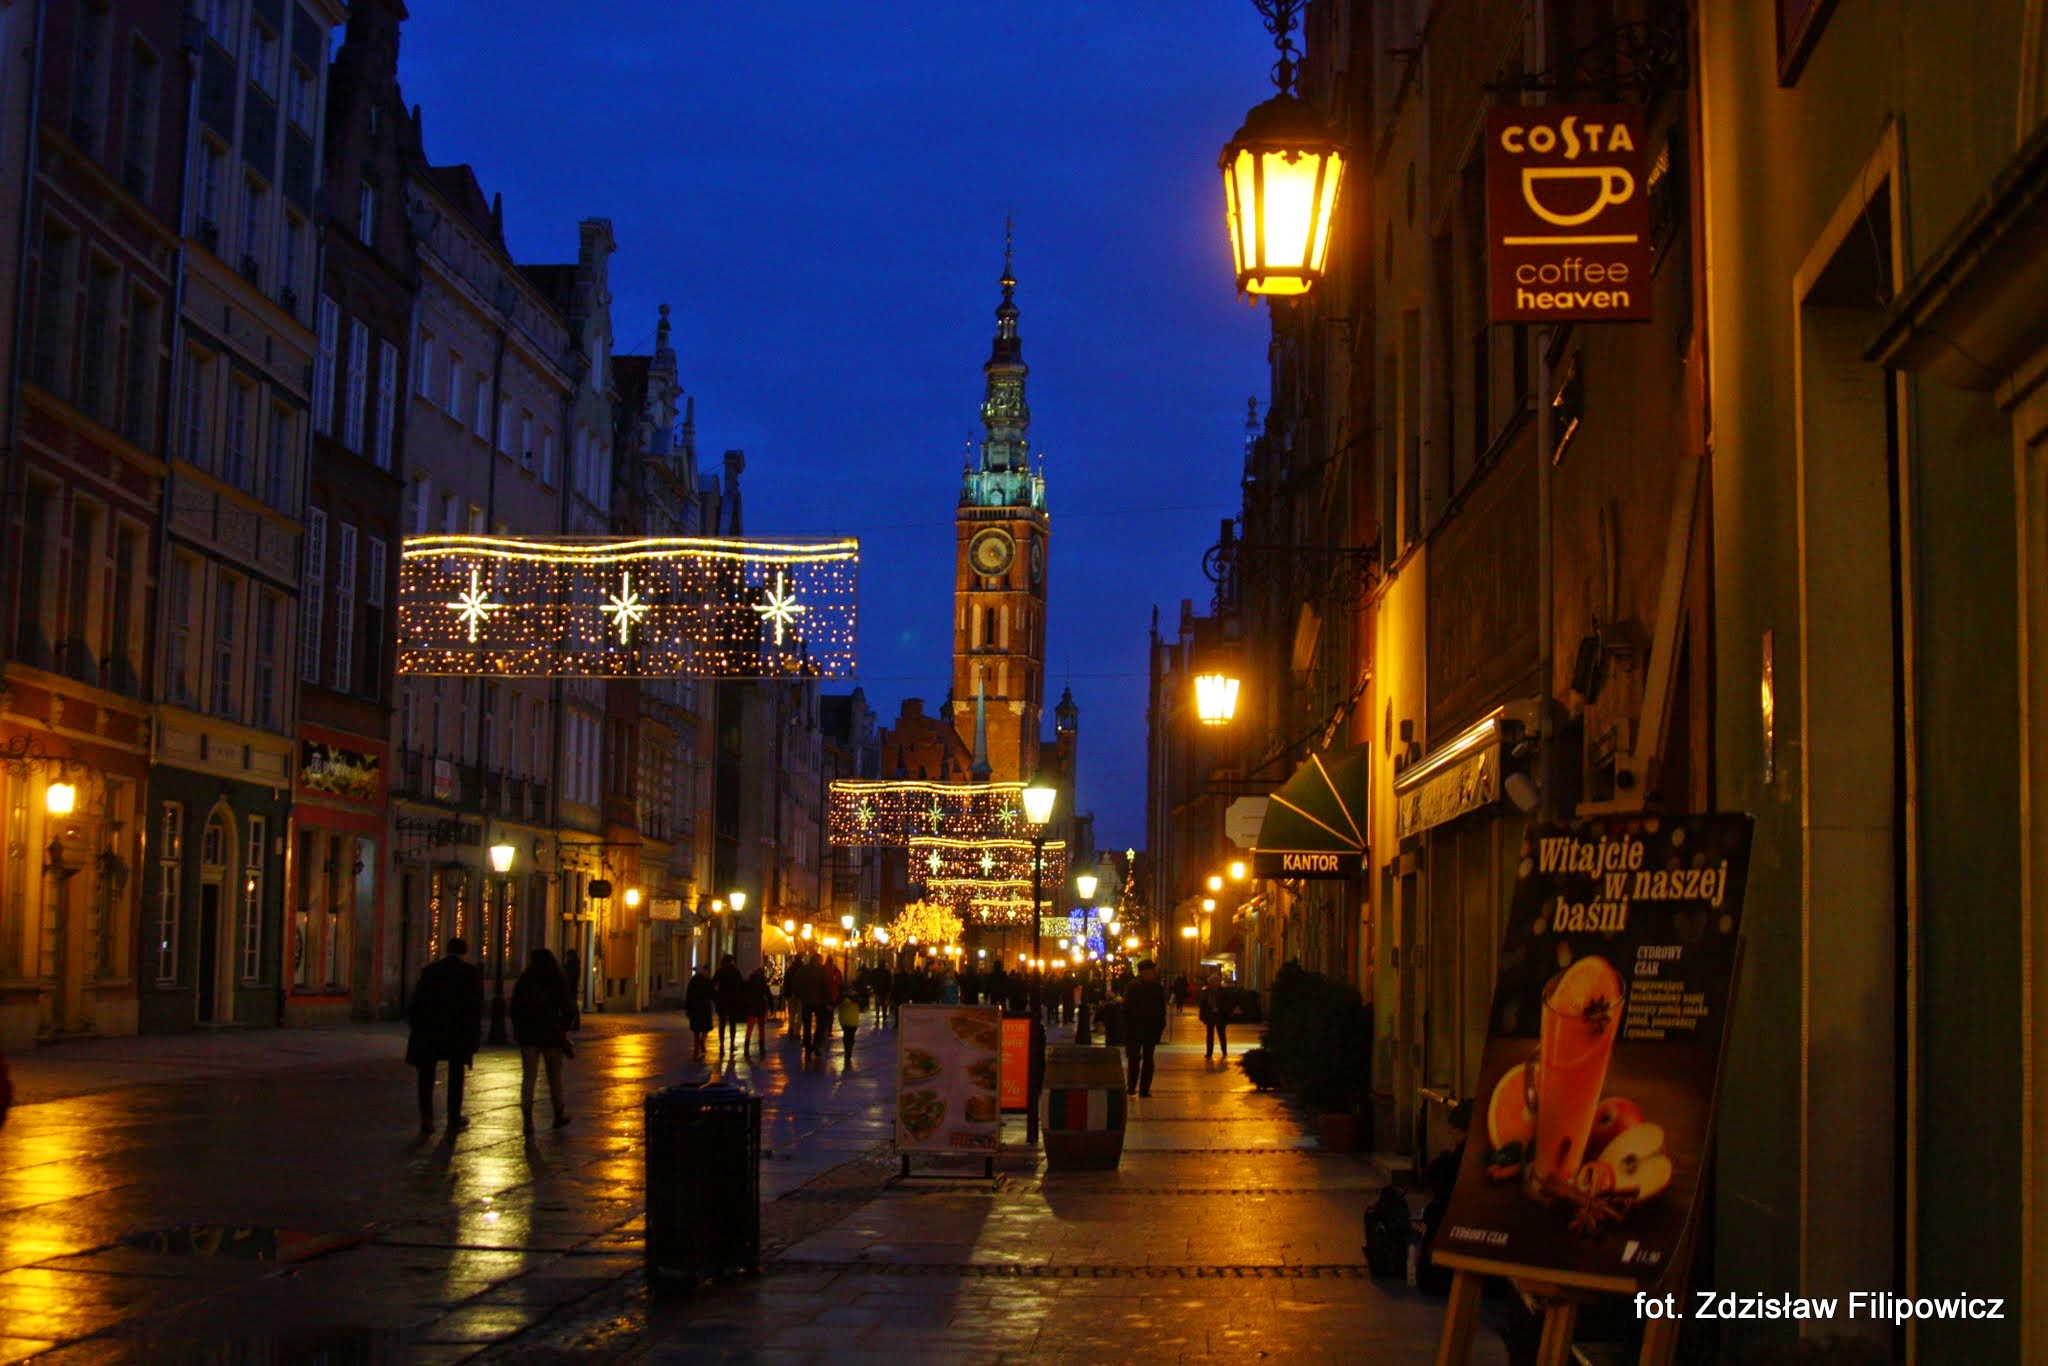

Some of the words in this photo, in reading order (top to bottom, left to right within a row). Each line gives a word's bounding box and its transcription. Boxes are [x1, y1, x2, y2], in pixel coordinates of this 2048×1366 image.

[1501, 116, 1634, 160] COSTA
[1516, 257, 1628, 284] coffee
[1517, 288, 1629, 309] heaven
[1283, 854, 1338, 871] KANTOR
[1539, 833, 1645, 879] Witajcie
[1604, 872, 1628, 901] w
[1632, 857, 1729, 908] naszej
[1552, 894, 1629, 932] baśni
